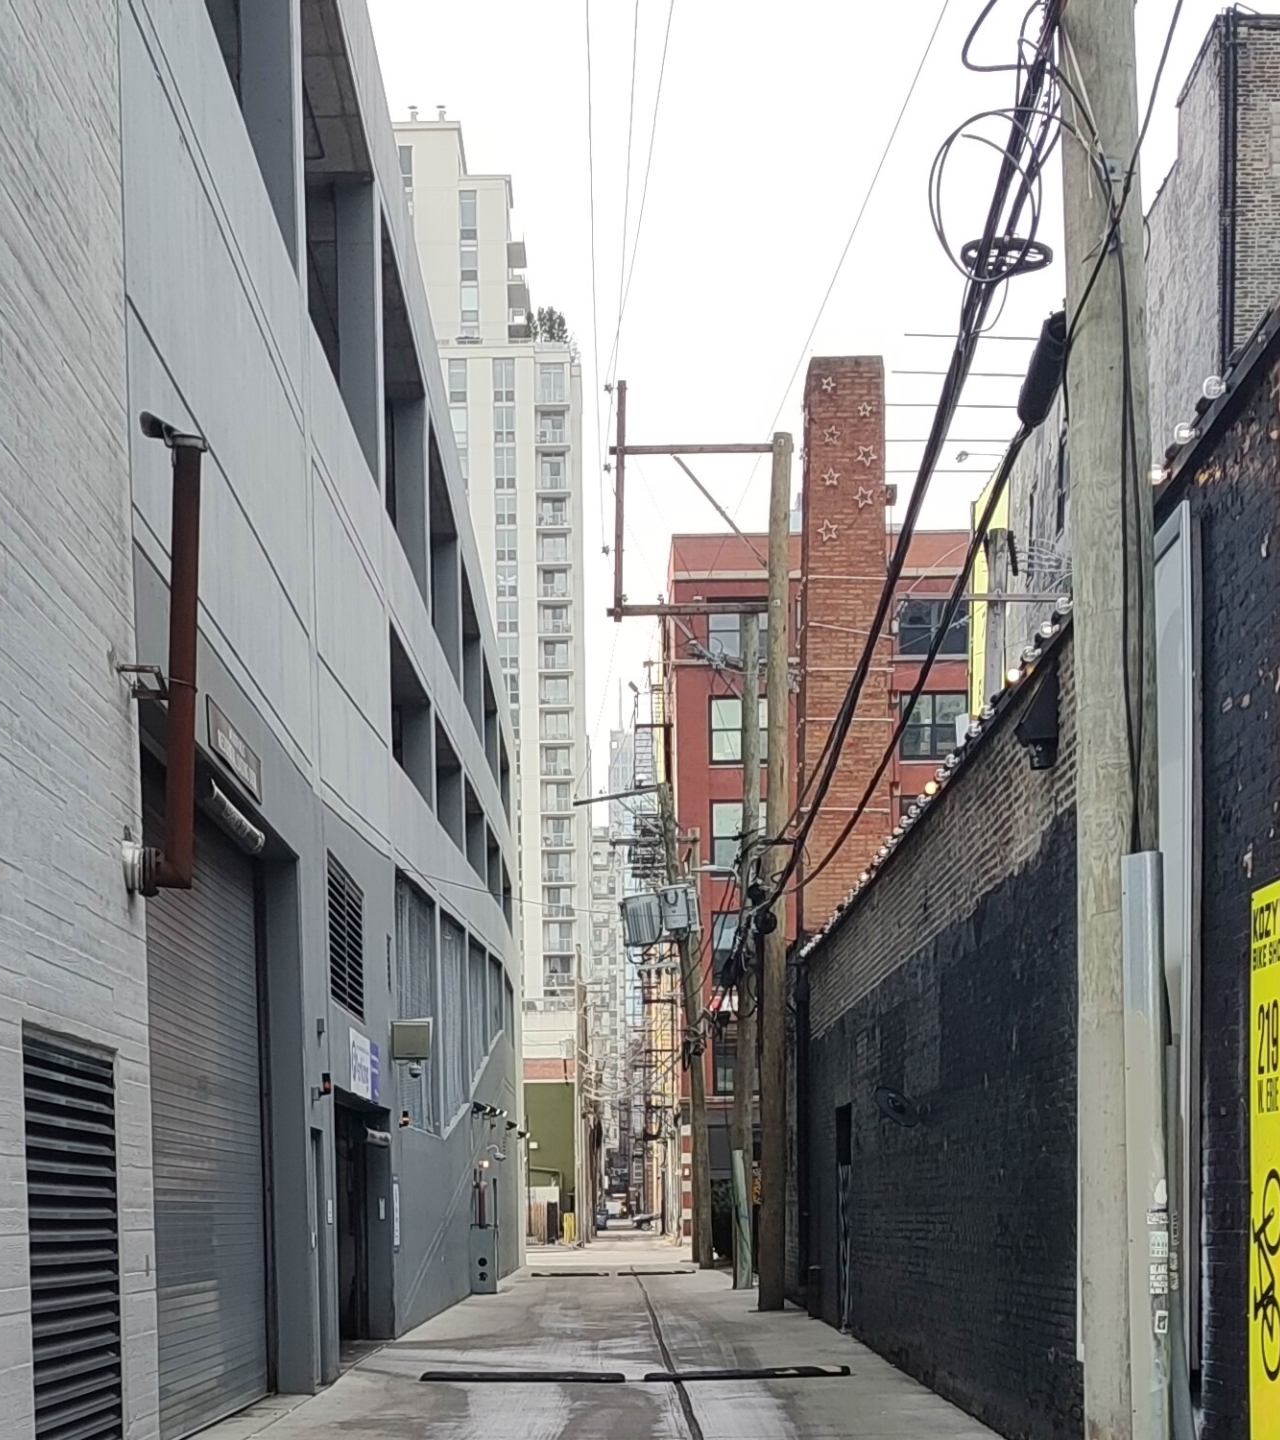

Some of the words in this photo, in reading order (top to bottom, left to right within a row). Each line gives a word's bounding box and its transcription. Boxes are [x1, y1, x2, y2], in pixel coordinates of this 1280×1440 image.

[1253, 944, 1267, 971] BIKE
[1258, 999, 1279, 1075] 219
[1257, 1079, 1265, 1114] W.
[1266, 1076, 1279, 1112] ERIE
